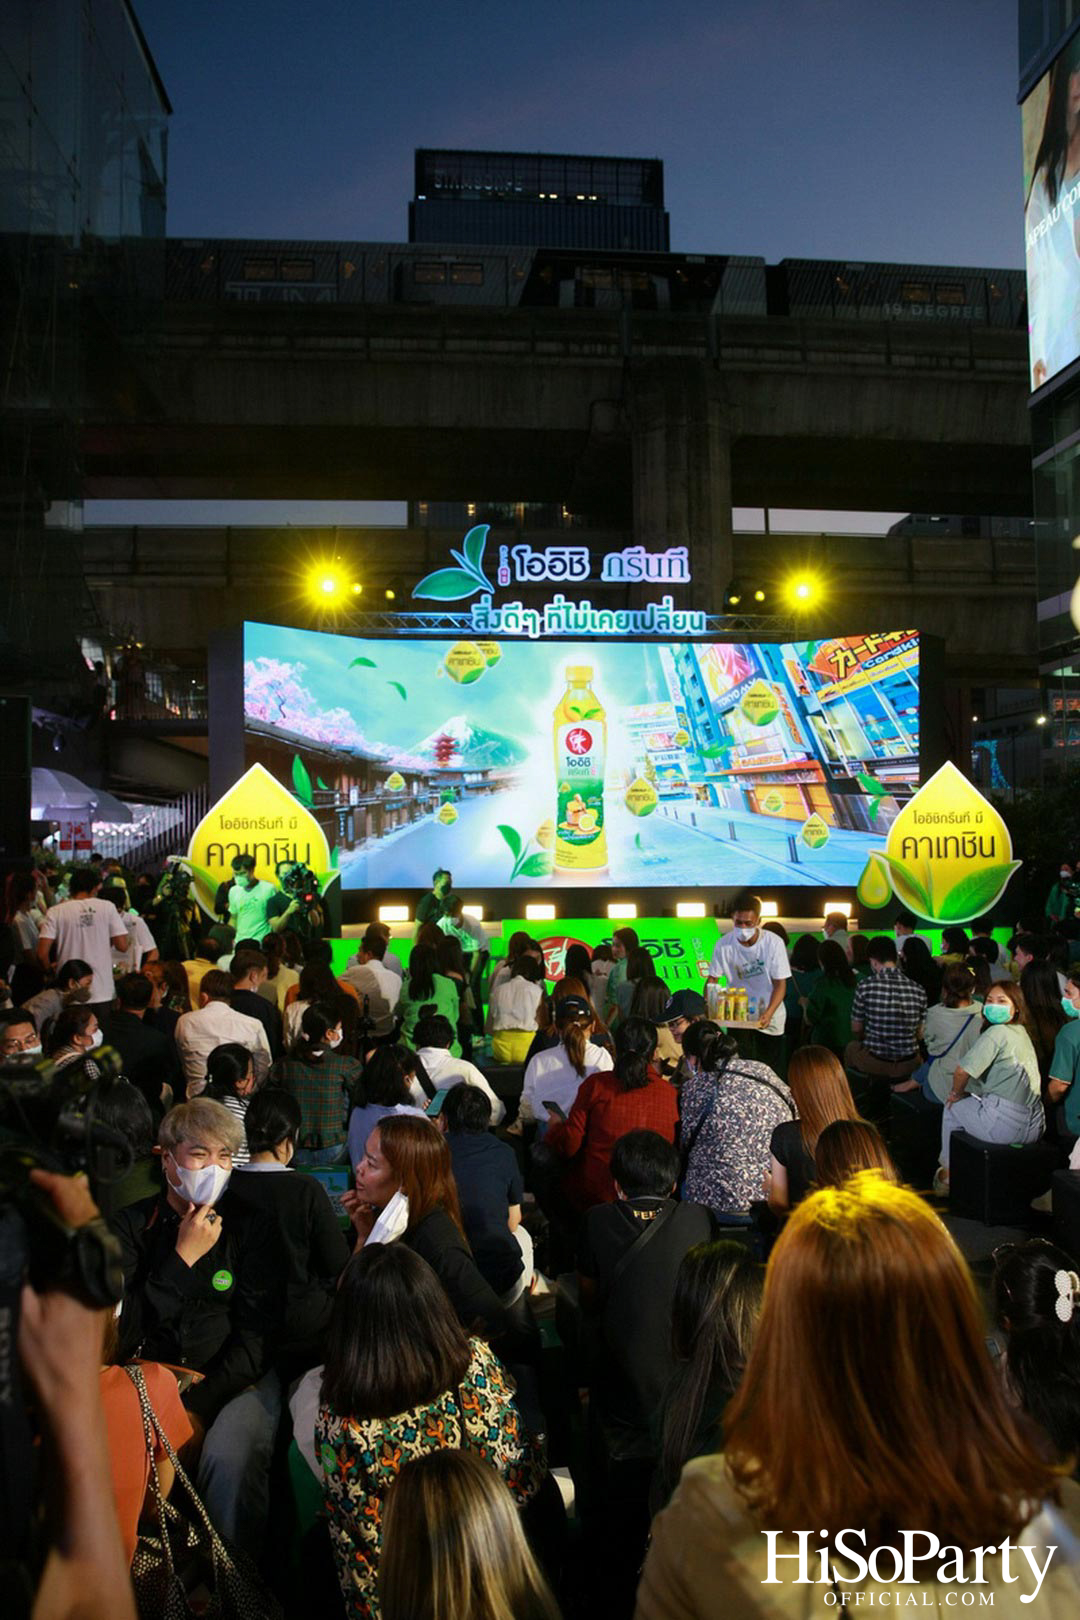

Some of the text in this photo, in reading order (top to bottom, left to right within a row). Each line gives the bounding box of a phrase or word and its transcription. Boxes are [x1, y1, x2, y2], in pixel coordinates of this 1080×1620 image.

[515, 549, 587, 577] โออิชิ
[606, 547, 688, 578] กรีนที
[546, 596, 704, 631] ที่ไม่เคยเปลี่ยน
[219, 816, 298, 830] โออิชิกรีนที มี
[913, 811, 983, 824] โออิชิกรีนที มี
[902, 831, 995, 859] คาเทชิน
